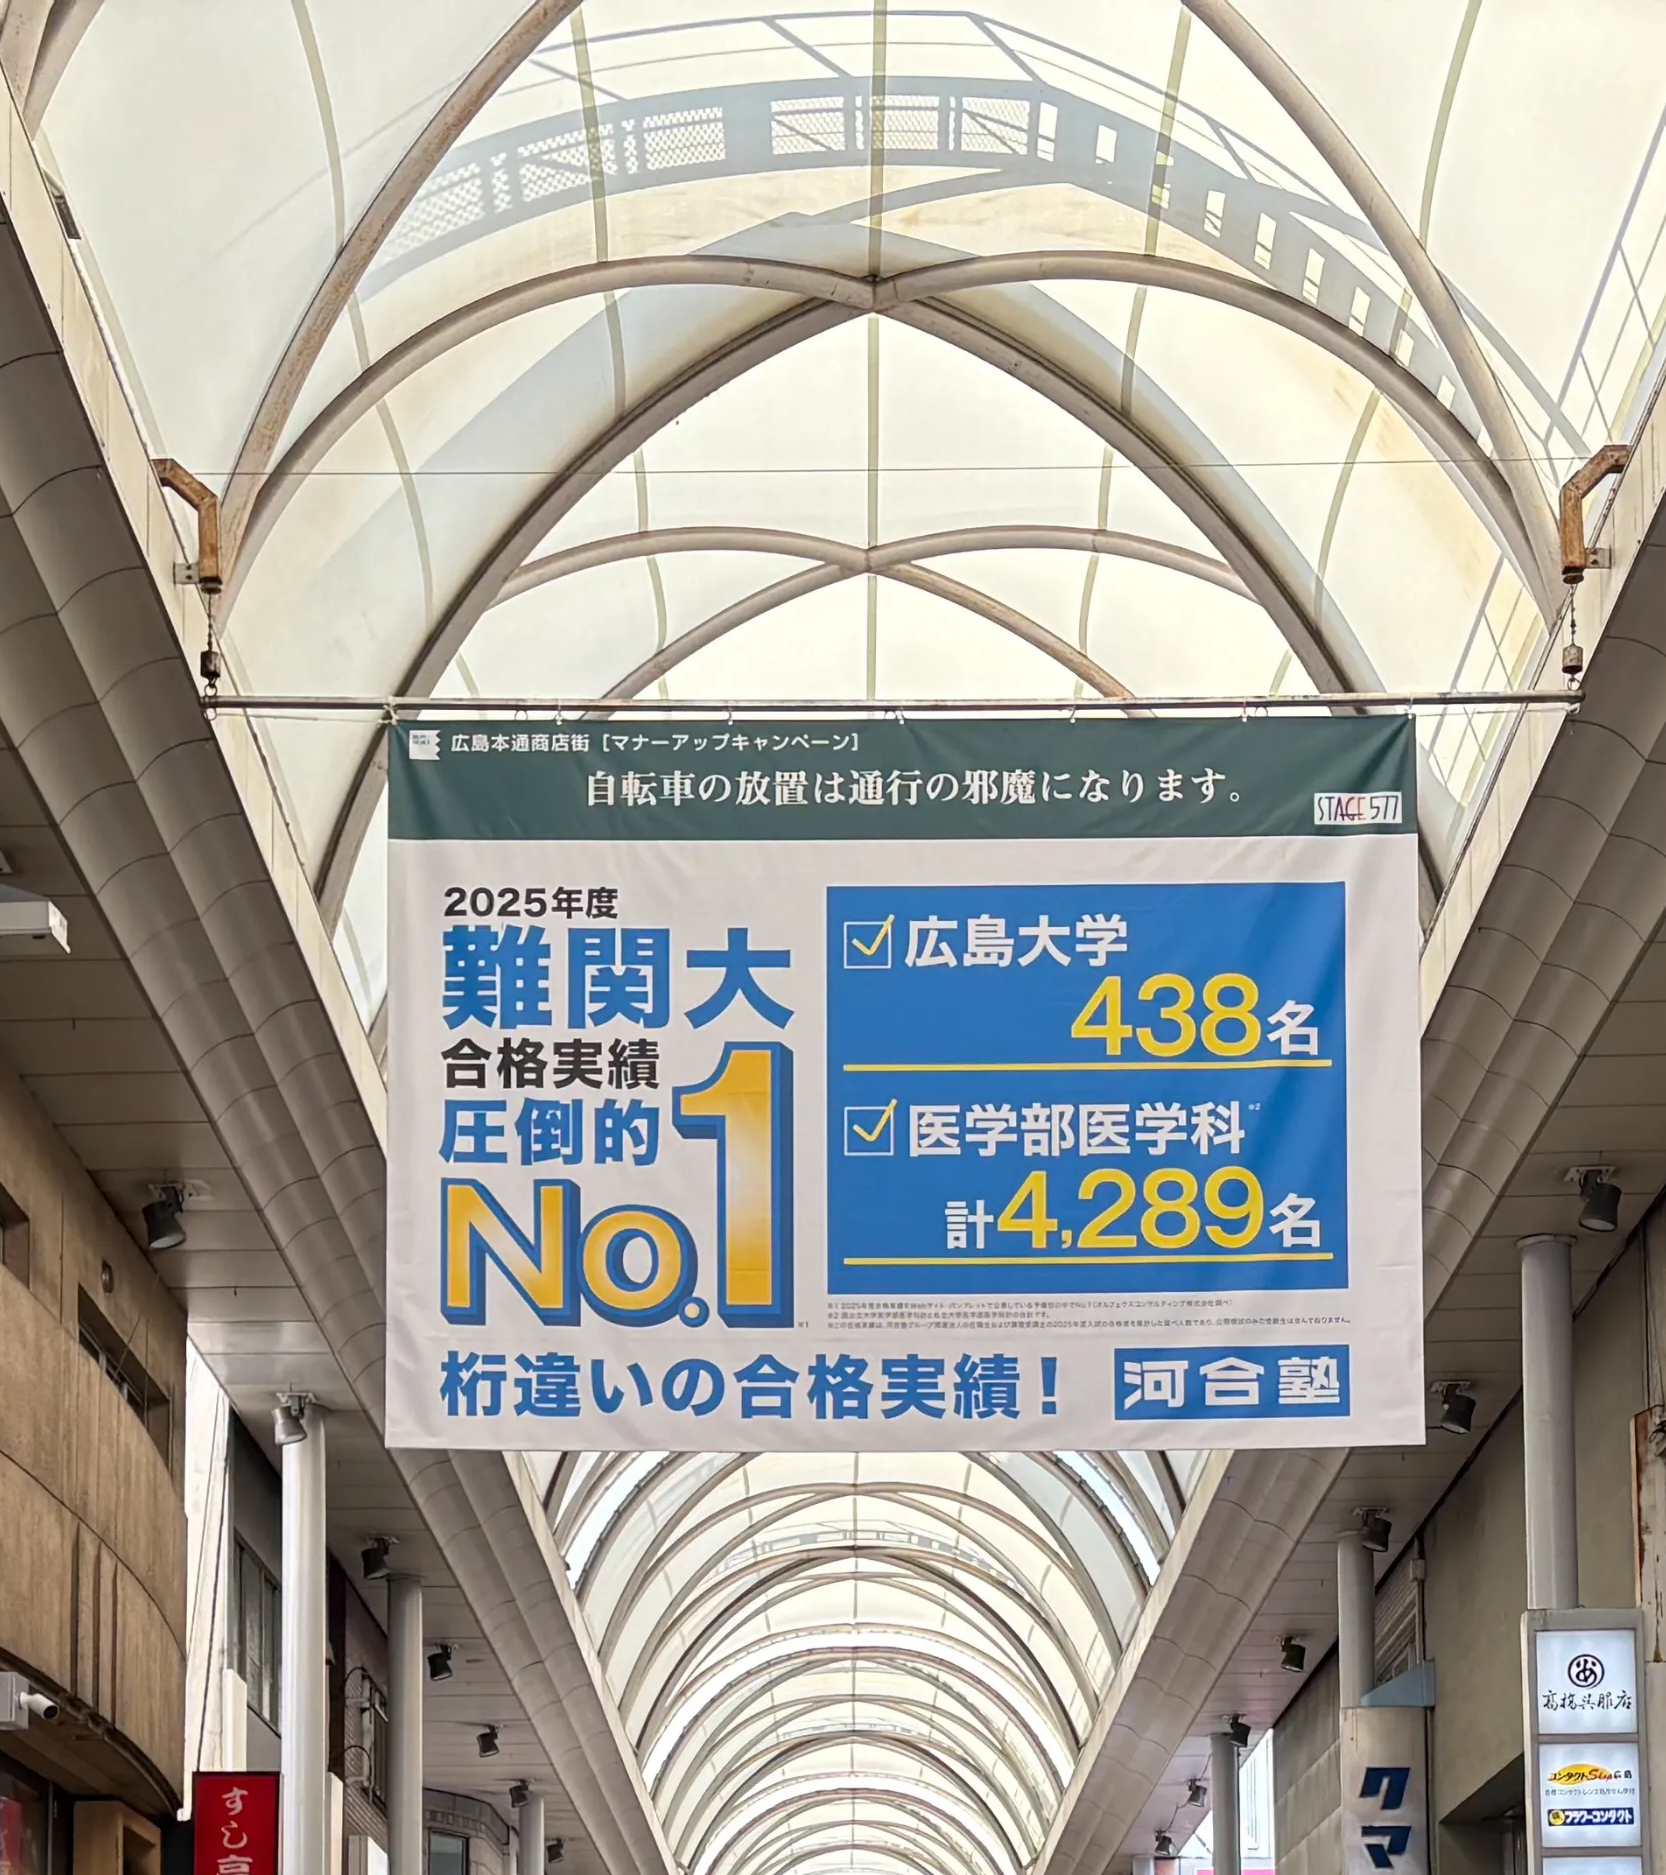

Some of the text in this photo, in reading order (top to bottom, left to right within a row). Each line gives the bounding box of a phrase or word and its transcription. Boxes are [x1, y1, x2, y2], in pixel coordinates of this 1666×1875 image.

[451, 733, 590, 753] 広島本通商店街
[585, 768, 1241, 807] 自転車の放置は通行の邪魔になります。
[443, 886, 619, 919] 2025年度
[904, 913, 1128, 968] 広島大学
[442, 924, 795, 1030] 難関大
[1071, 973, 1320, 1057] 438名
[441, 1037, 660, 1090] 合格実績
[439, 1097, 660, 1166] 圧倒的
[907, 1101, 1245, 1157] 医学部医学科
[945, 1165, 1322, 1251] 計4,289名
[440, 1350, 1058, 1420] 桁違いの合格実績！
[1123, 1356, 1341, 1411] 河合塾
